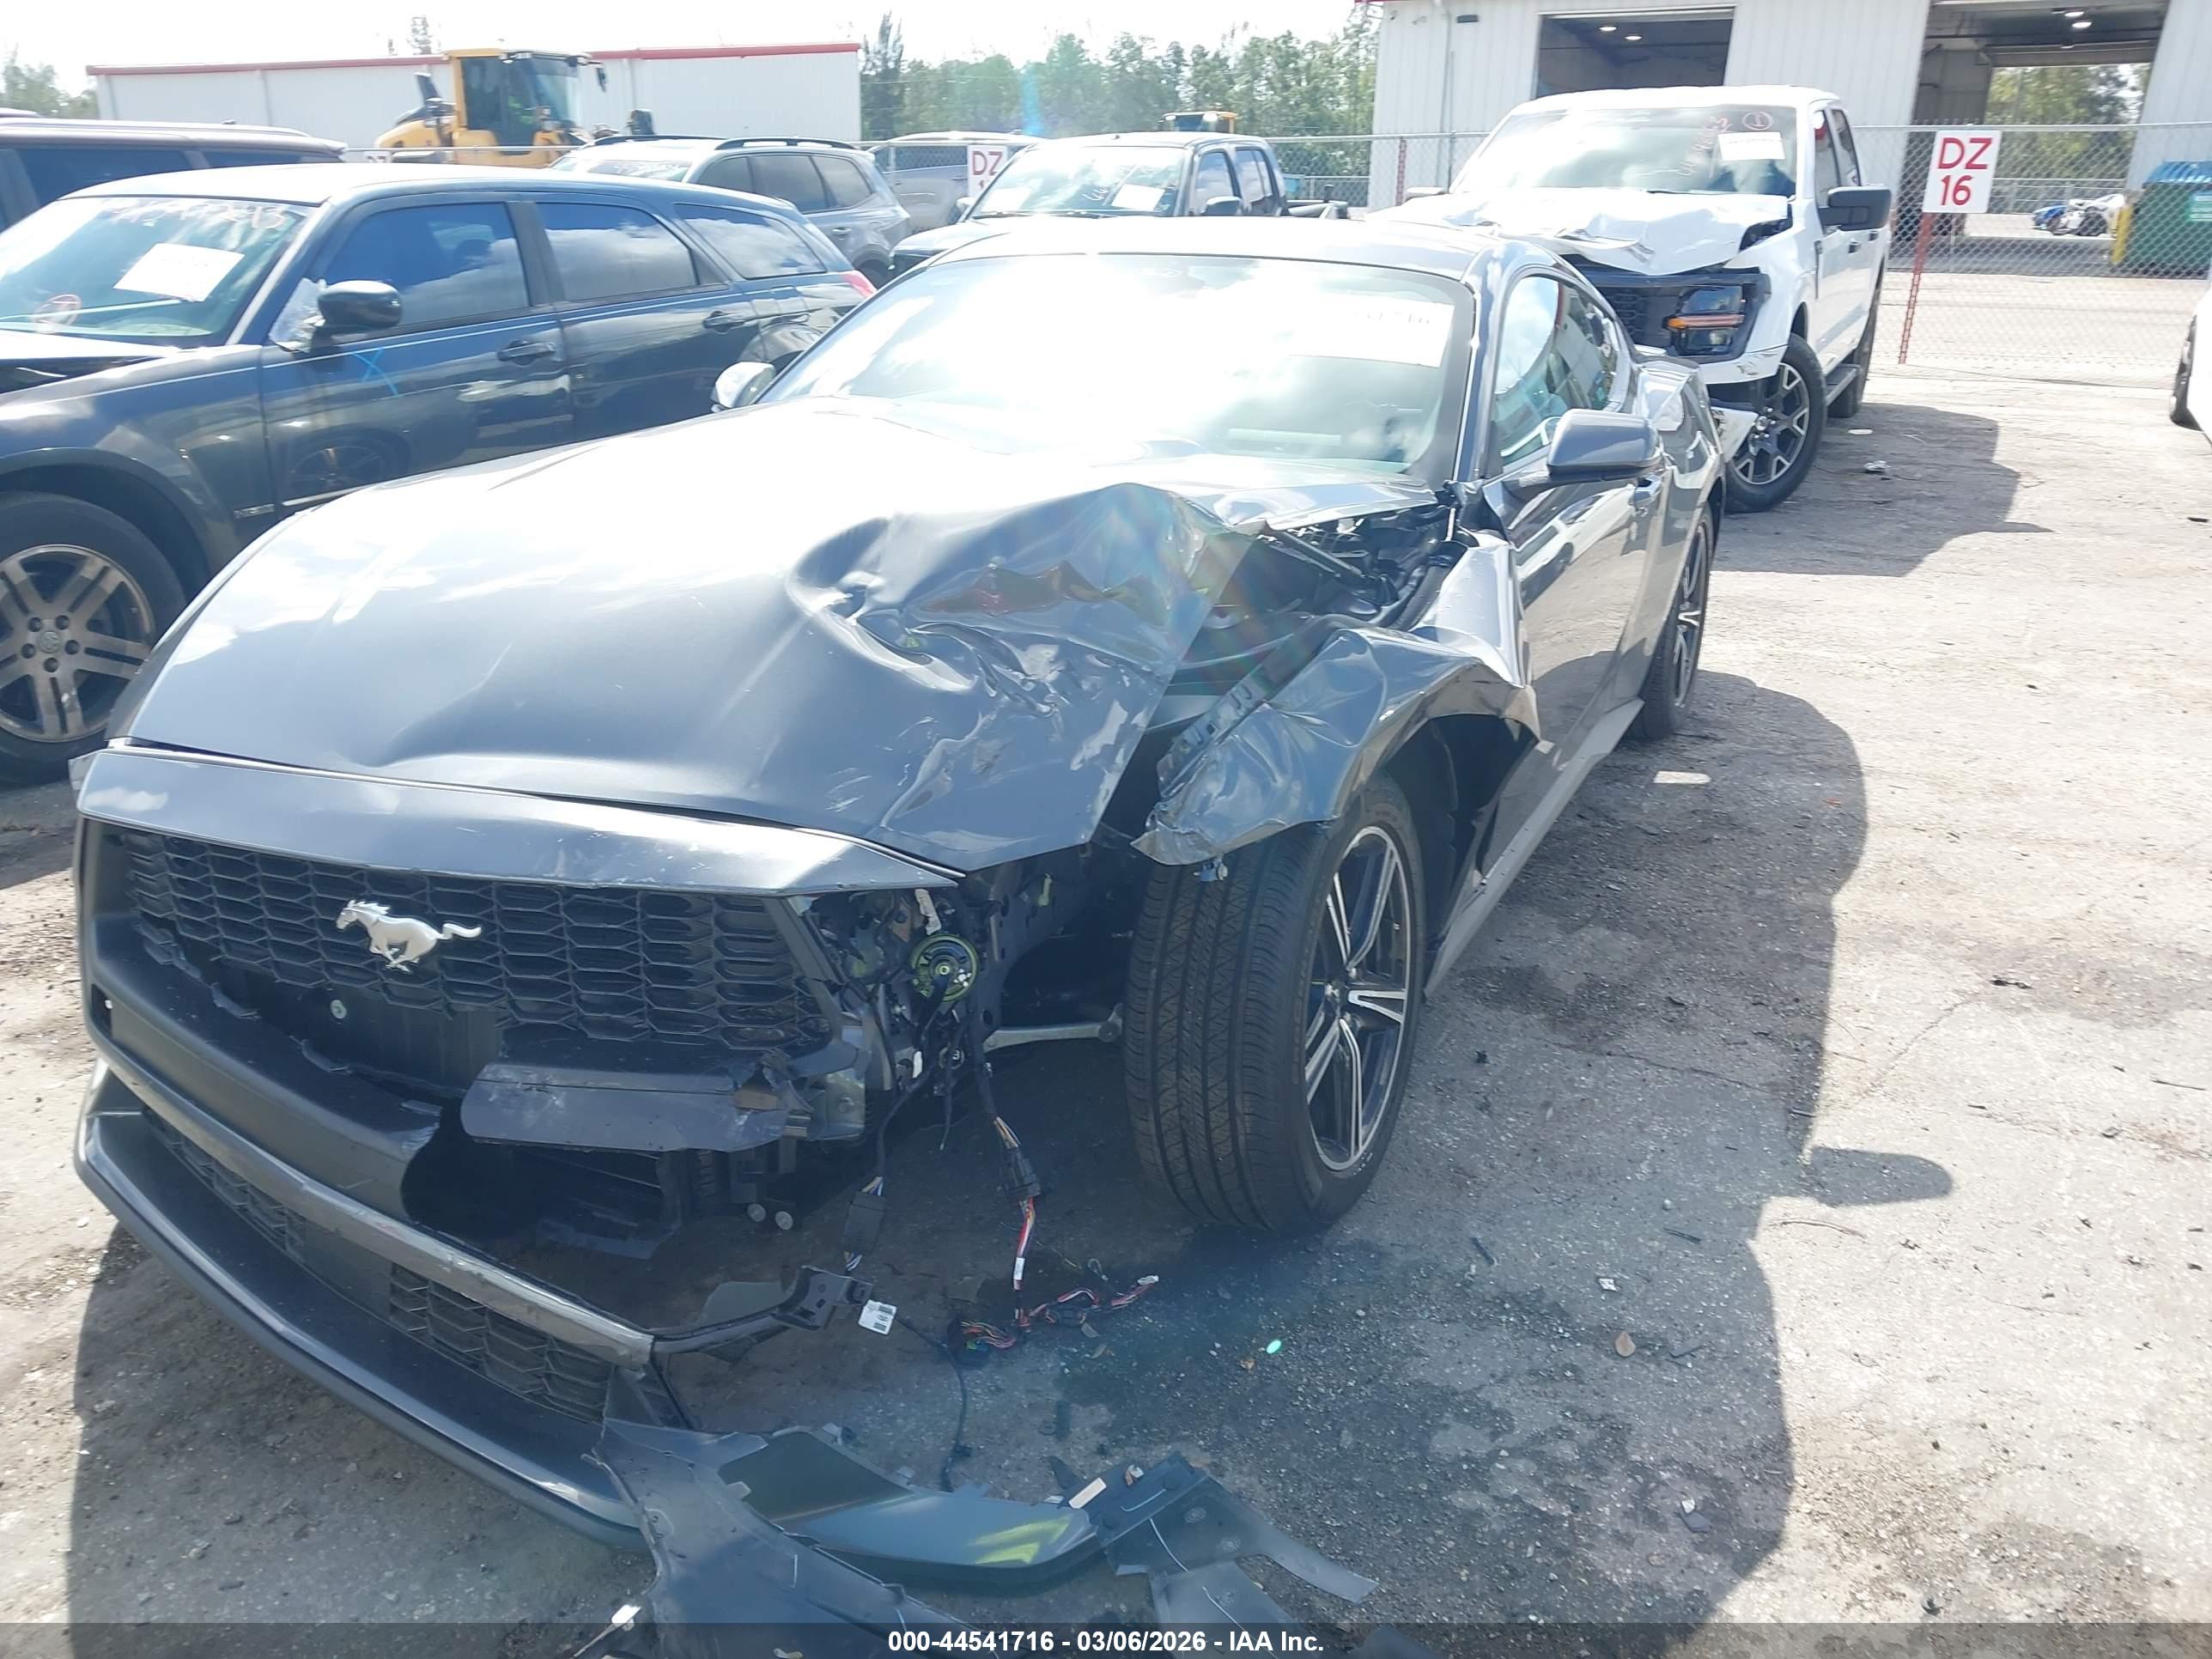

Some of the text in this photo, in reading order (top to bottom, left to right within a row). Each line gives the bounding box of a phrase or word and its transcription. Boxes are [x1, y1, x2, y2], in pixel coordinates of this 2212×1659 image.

[972, 150, 1003, 176] DZ
[1937, 137, 1992, 169] DZ
[1941, 174, 1973, 205] 16
